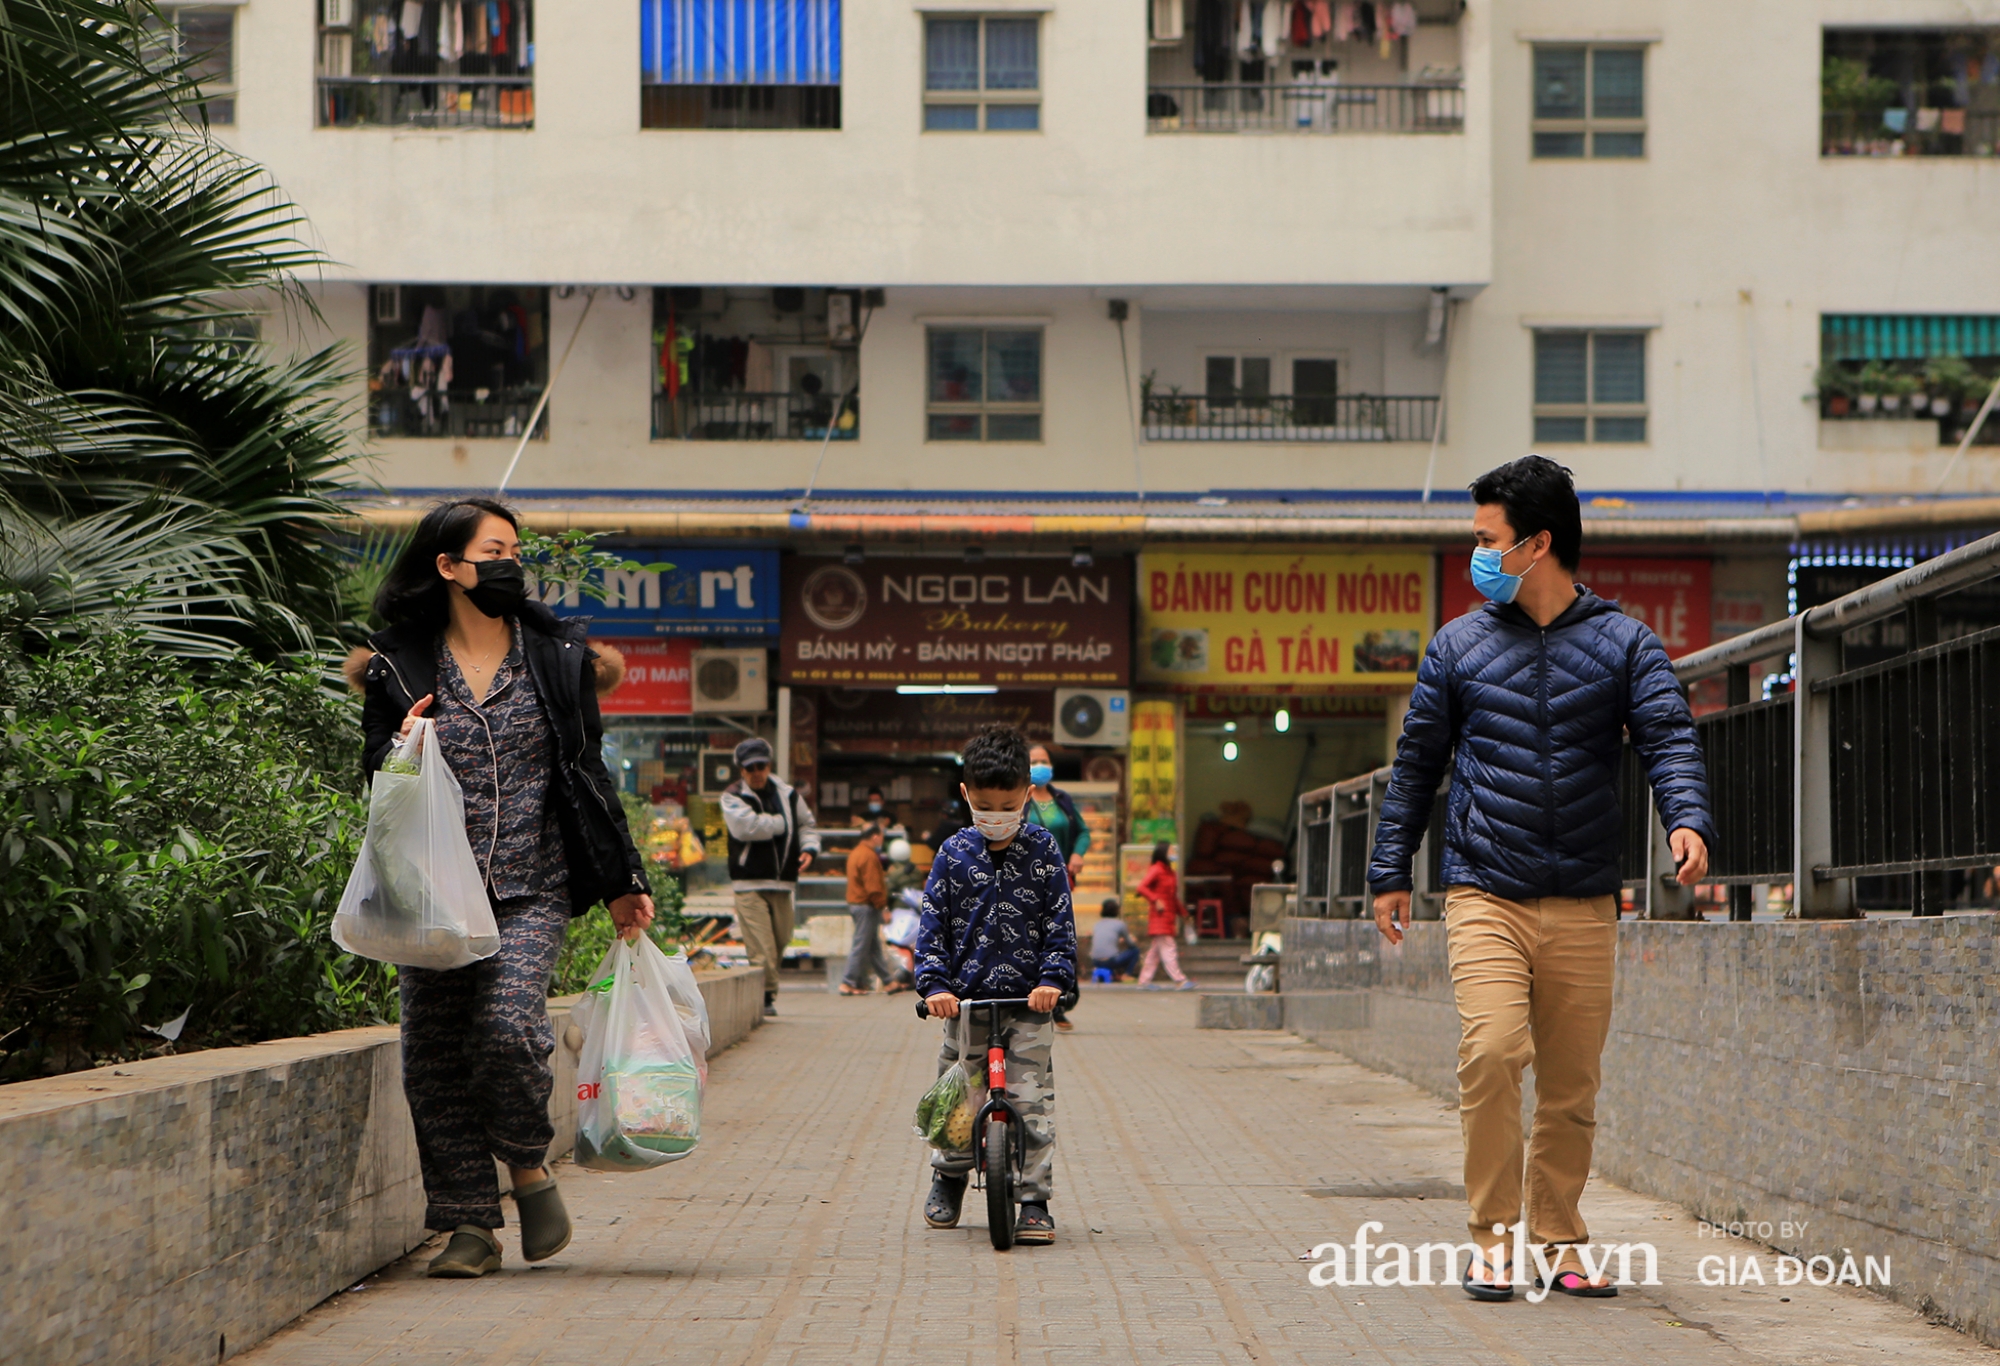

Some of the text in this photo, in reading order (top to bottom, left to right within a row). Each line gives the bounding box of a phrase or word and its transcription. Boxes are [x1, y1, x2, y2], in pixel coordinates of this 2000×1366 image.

[883, 575, 1109, 610] NGỌC LAN
[1151, 556, 1421, 614] BÁNH CUỐN NÓNG
[925, 610, 1069, 638] Bakery
[798, 635, 858, 660] BÁNH
[866, 635, 896, 660] MỲ
[917, 636, 979, 661] BÁNH
[985, 643, 1047, 667] NGỌT
[1052, 636, 1111, 661] PHÁP
[1225, 629, 1267, 674] GÀ
